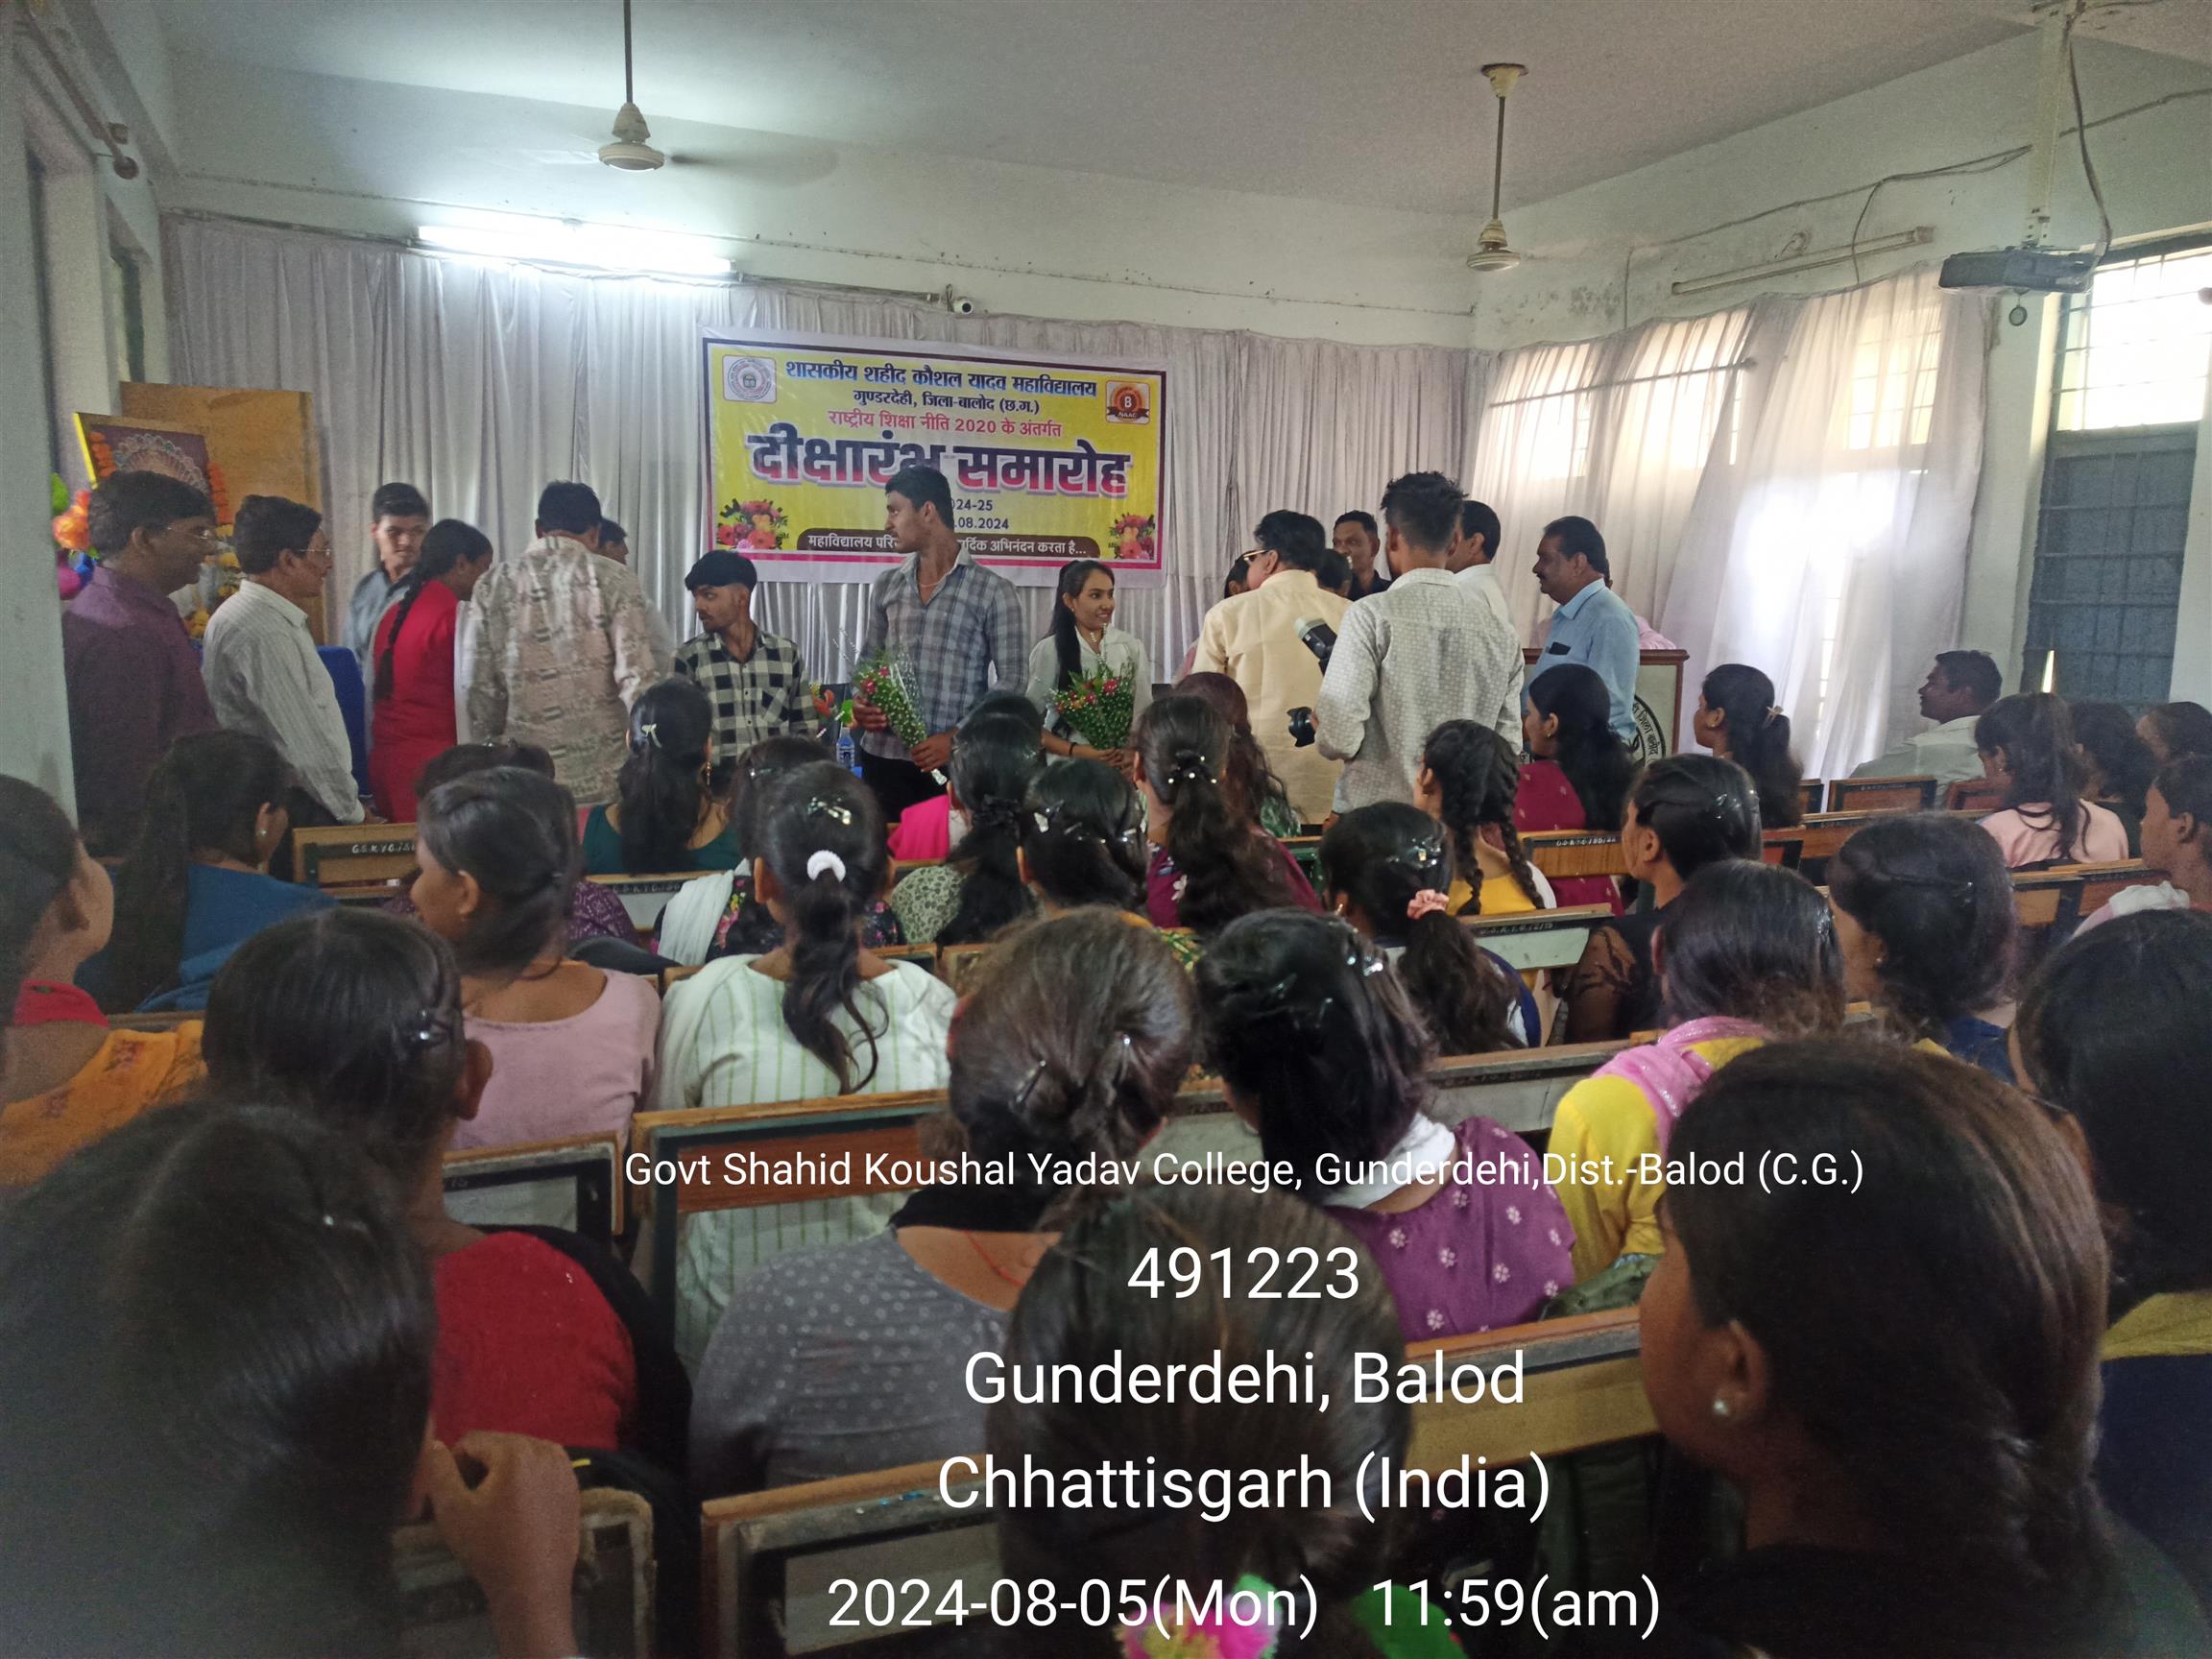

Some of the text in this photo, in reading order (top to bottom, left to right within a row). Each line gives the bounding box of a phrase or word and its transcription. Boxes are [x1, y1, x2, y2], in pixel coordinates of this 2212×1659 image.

[785, 359, 858, 382] शासकीय
[864, 362, 907, 386] शहीद
[912, 364, 962, 388] कौशल
[968, 373, 1007, 392] यादव
[1012, 373, 1097, 397] महाविद्यालय
[999, 397, 1040, 414] (छ.ग.)
[829, 409, 1062, 438] राष्ट्रीय शिक्षा नीति 2020 के अंतर्गत
[952, 439, 1134, 494] समारोह
[952, 499, 993, 512] 24-25
[955, 517, 1009, 530] .08.2024
[807, 532, 874, 549] महाविद्यालय
[876, 534, 900, 549] परि
[990, 538, 1035, 553] अभिनंदन
[1038, 541, 1066, 555] करता
